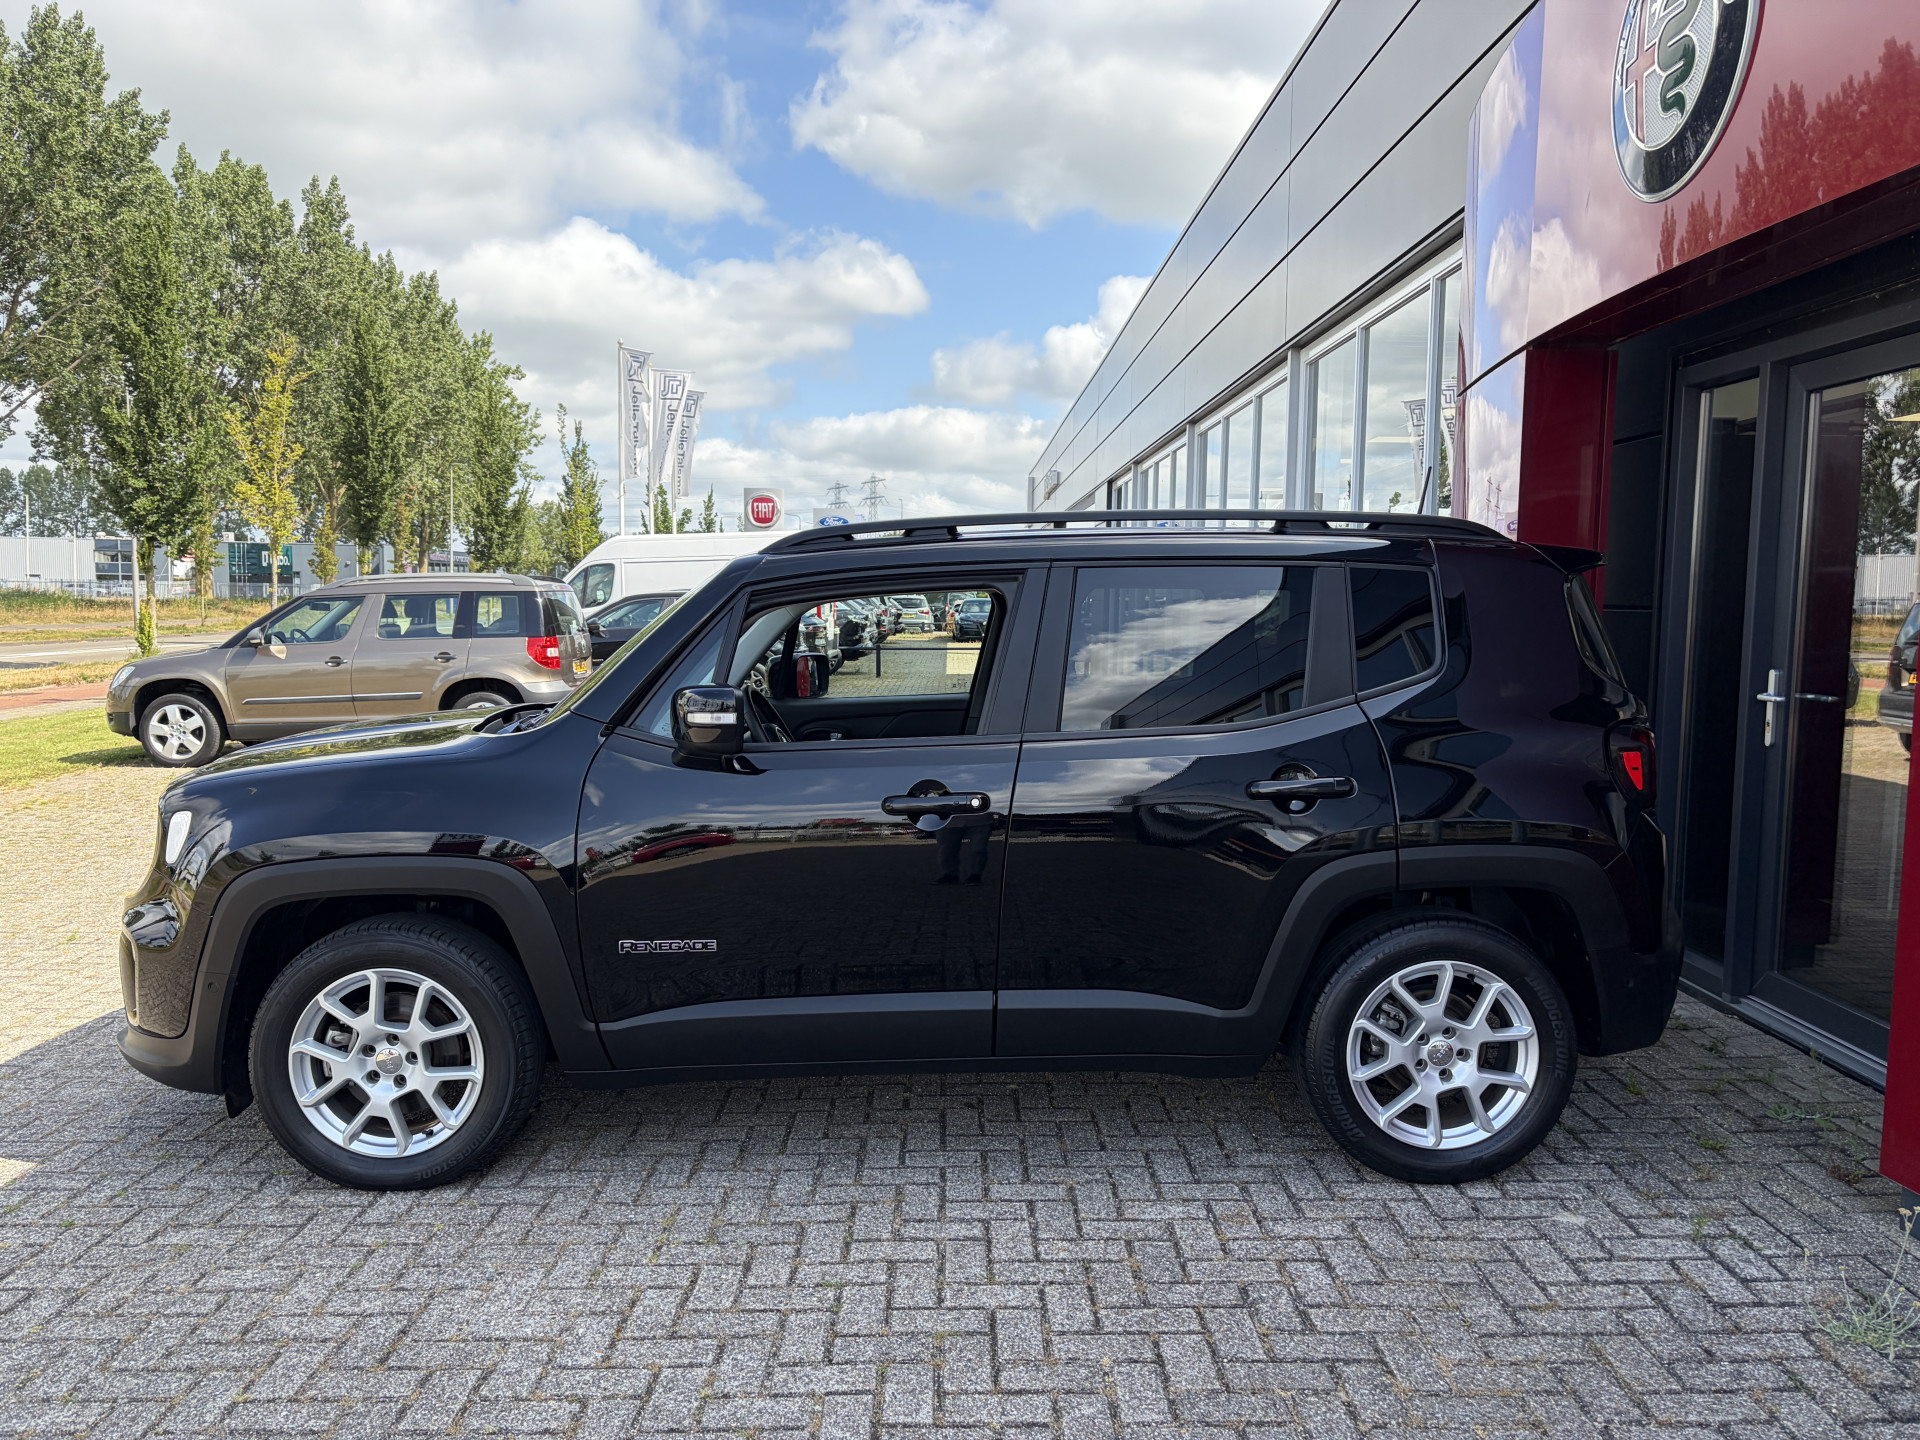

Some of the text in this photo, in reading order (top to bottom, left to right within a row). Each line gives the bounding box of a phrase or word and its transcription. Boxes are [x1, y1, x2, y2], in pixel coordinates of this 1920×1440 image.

[753, 502, 774, 519] FIAT
[824, 517, 844, 526] Ford
[618, 939, 717, 953] RENEGADE
[1523, 974, 1569, 1081] BRIDGESTONE
[1320, 1035, 1367, 1142] BRIDGESTONE
